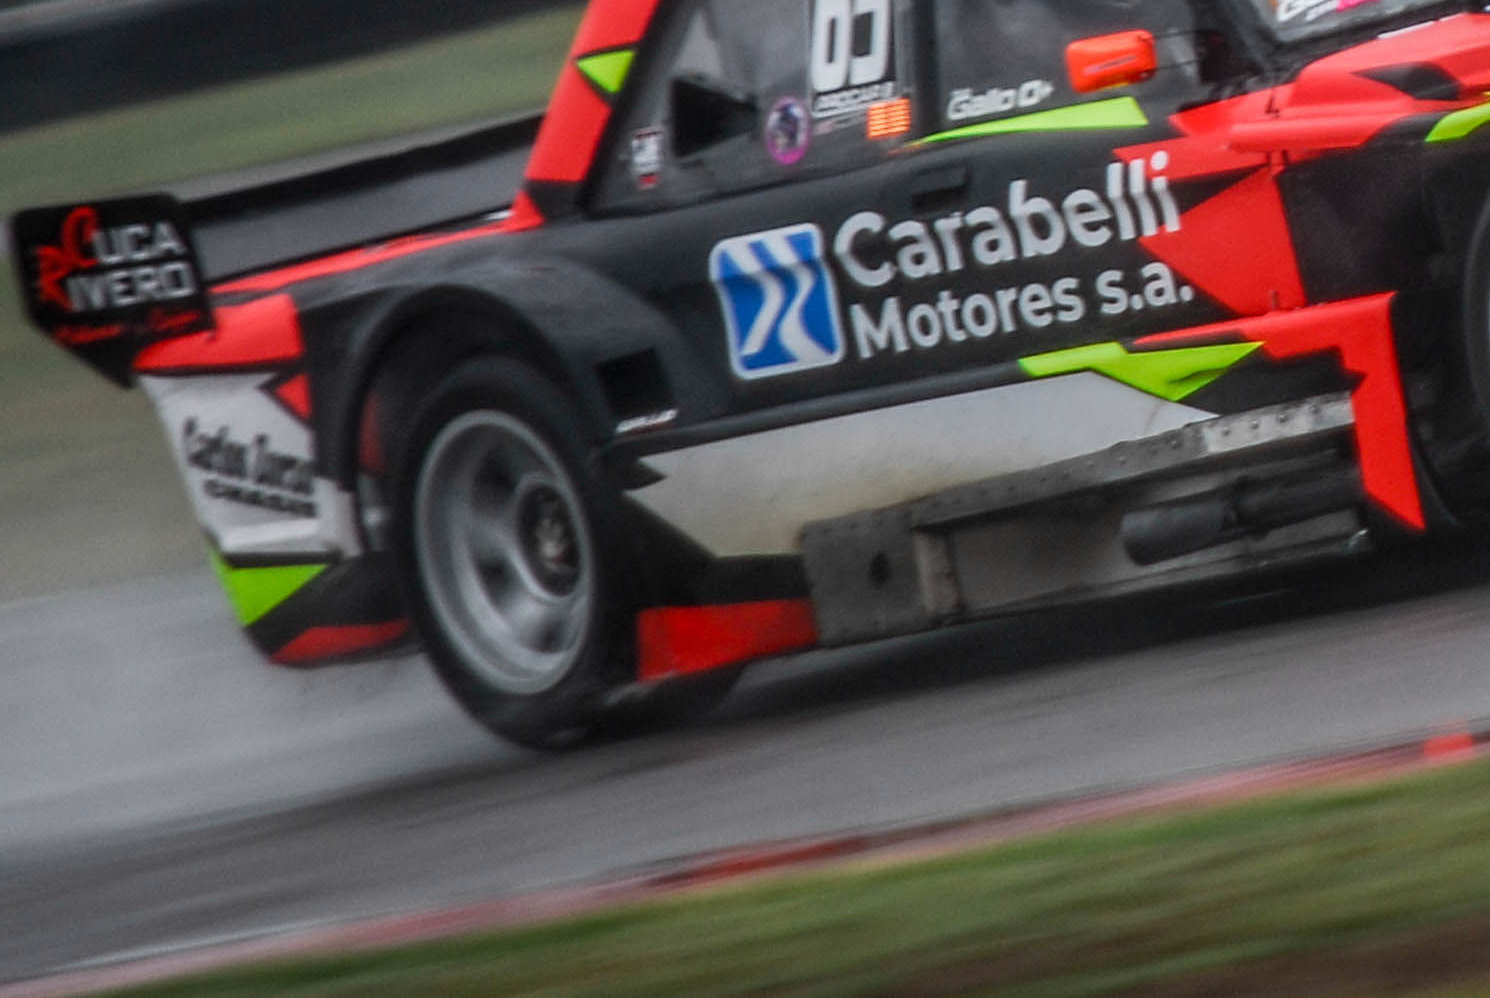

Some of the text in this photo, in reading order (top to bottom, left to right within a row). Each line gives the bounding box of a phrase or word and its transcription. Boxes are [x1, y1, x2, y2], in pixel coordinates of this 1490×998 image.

[833, 150, 1181, 288] Carabelli
[850, 261, 1196, 359] Motores s.a.
